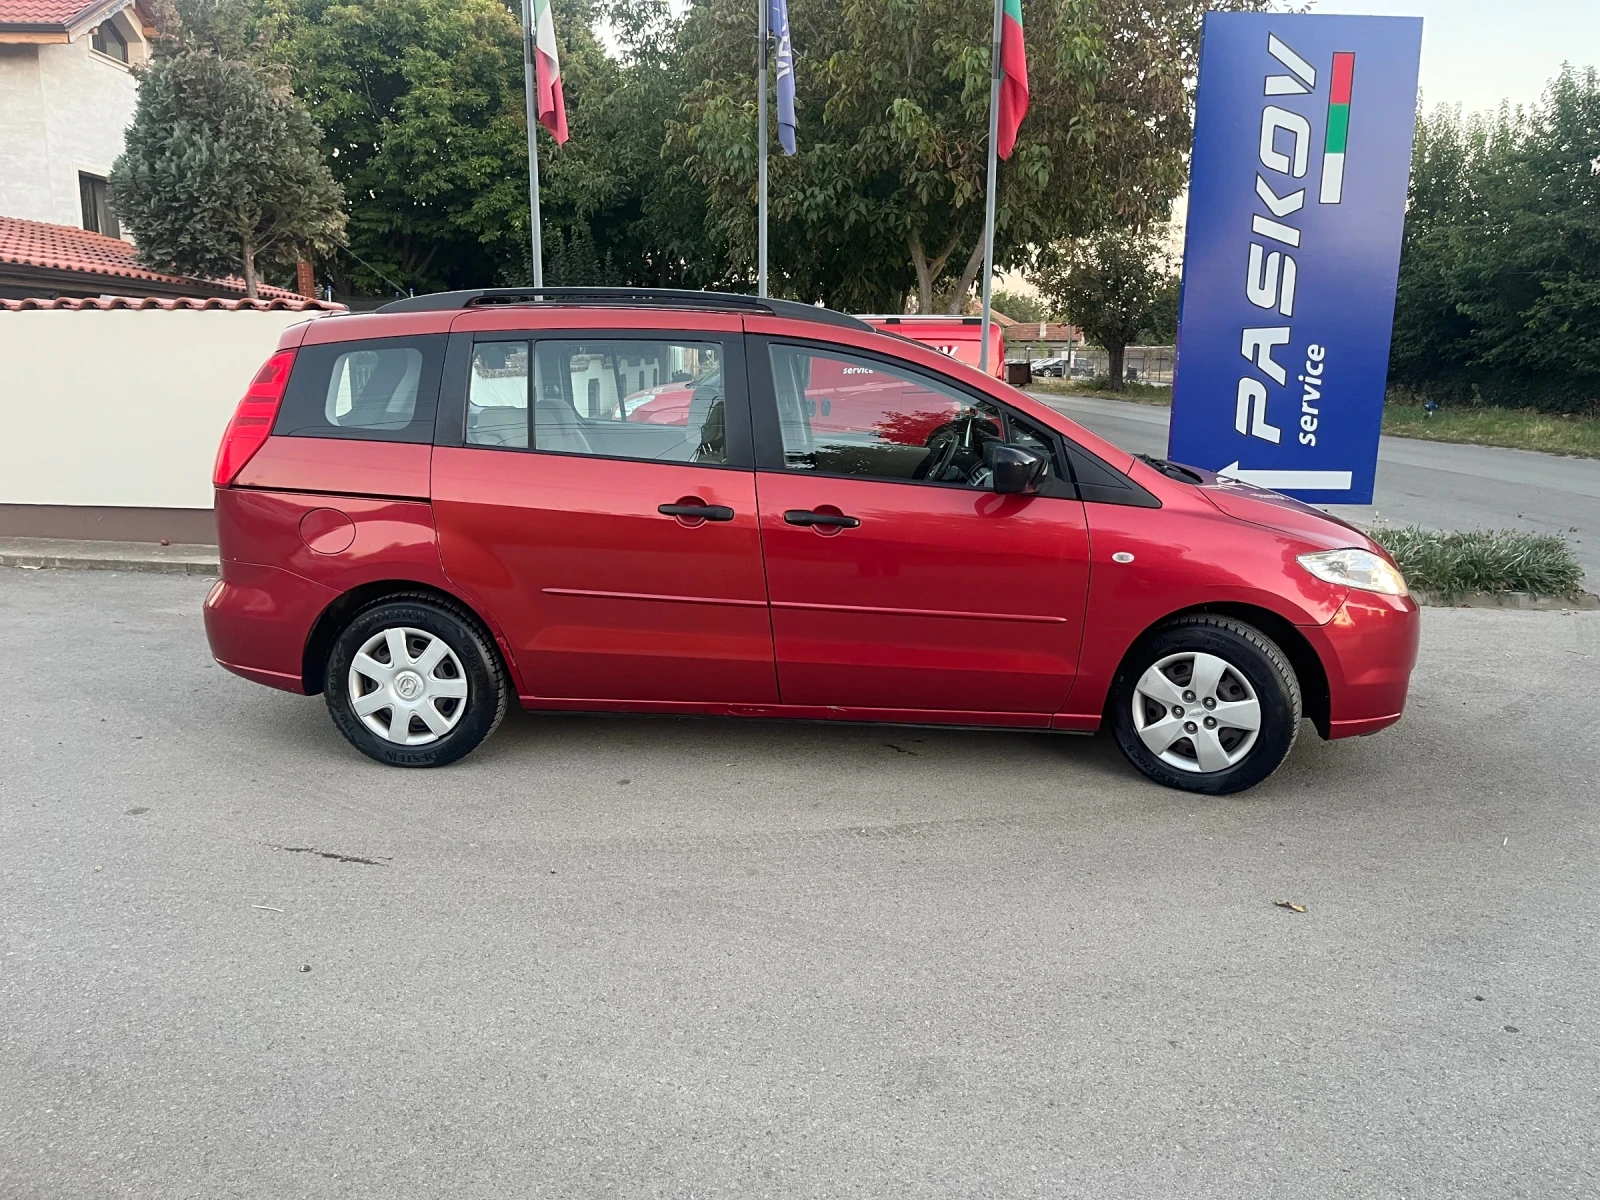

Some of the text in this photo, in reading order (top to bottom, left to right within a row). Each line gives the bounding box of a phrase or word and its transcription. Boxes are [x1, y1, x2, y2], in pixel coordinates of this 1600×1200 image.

[1235, 31, 1317, 445] PASKOV
[842, 367, 874, 375] service
[1298, 343, 1325, 447] service
